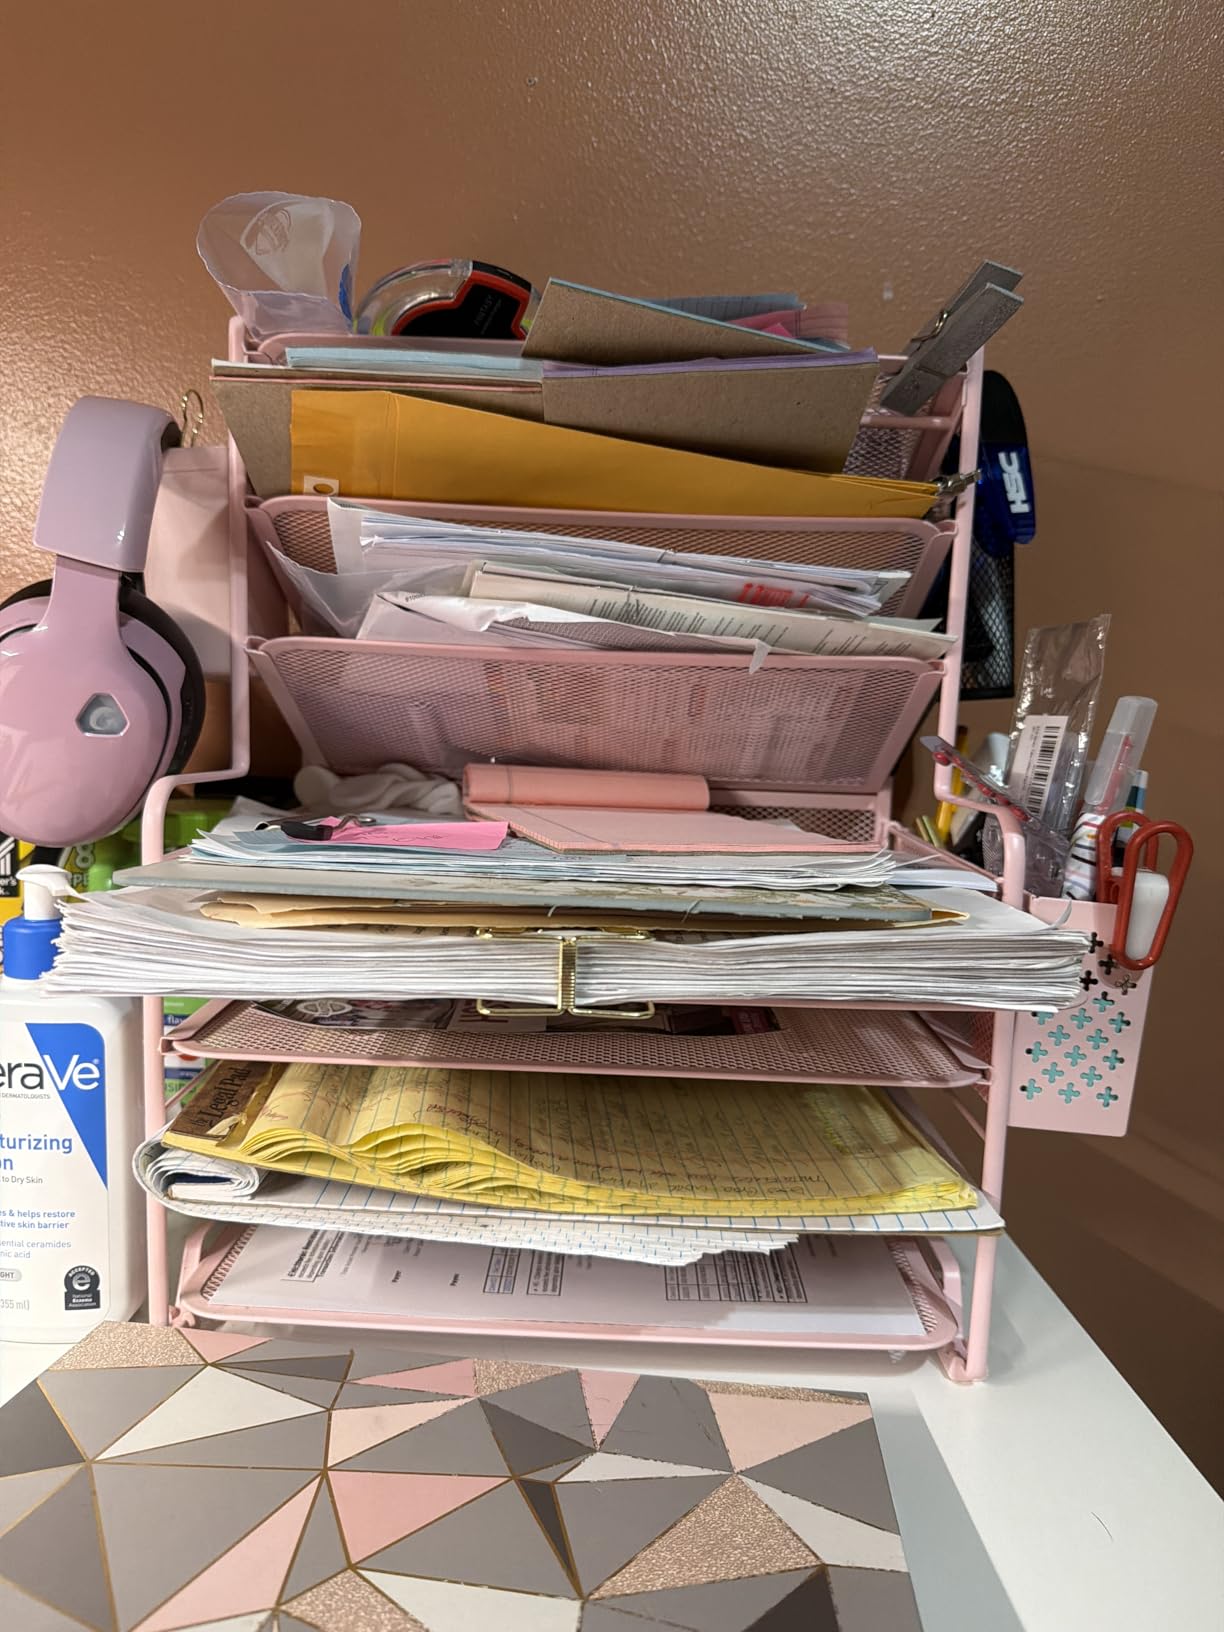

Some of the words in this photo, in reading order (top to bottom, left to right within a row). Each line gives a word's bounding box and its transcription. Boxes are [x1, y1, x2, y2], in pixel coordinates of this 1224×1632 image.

[0, 1054, 100, 1091] raVe
[198, 1082, 240, 1120] Legal
[223, 1066, 252, 1088] Pad
[2, 1175, 10, 1183] to
[11, 1175, 24, 1184] Dry
[25, 1176, 44, 1184] Skin
[17, 1209, 41, 1219] helps
[17, 1220, 36, 1229] skin
[37, 1221, 70, 1229] barrier
[26, 1240, 72, 1249] ceramides
[14, 1250, 31, 1259] acid
